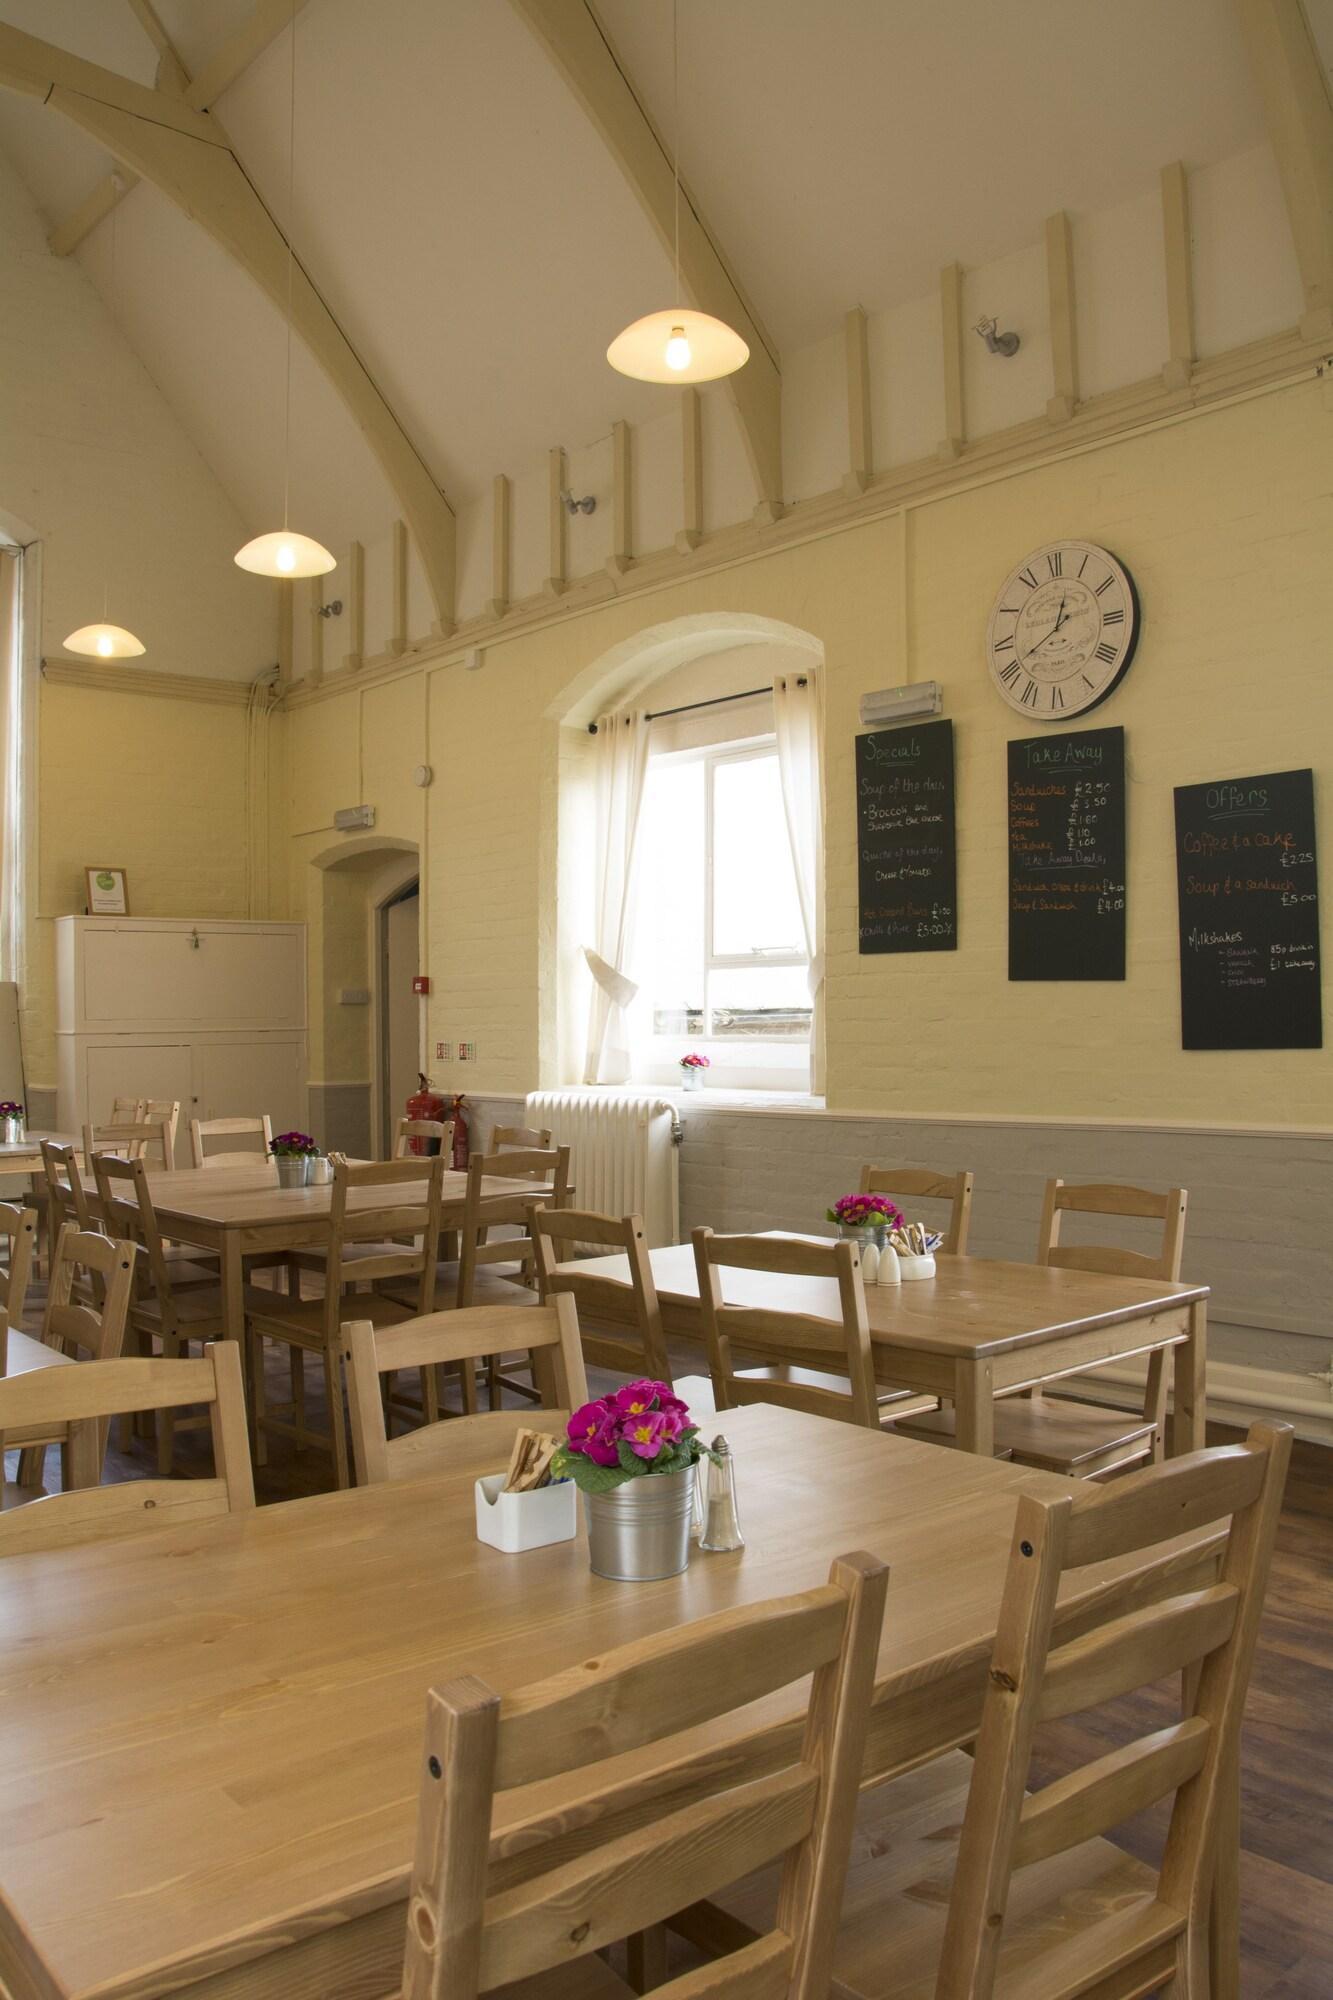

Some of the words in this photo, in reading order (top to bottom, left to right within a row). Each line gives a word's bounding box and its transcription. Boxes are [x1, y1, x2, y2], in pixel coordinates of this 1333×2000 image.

[864, 735, 921, 761] Specials
[1023, 741, 1062, 769] Take
[1064, 742, 1103, 767] Away
[860, 777, 885, 801] Soup
[1205, 785, 1269, 810] Offers
[1184, 831, 1231, 858] Coffee
[1186, 874, 1220, 897] Soup
[1188, 927, 1243, 953] Milkshakes
